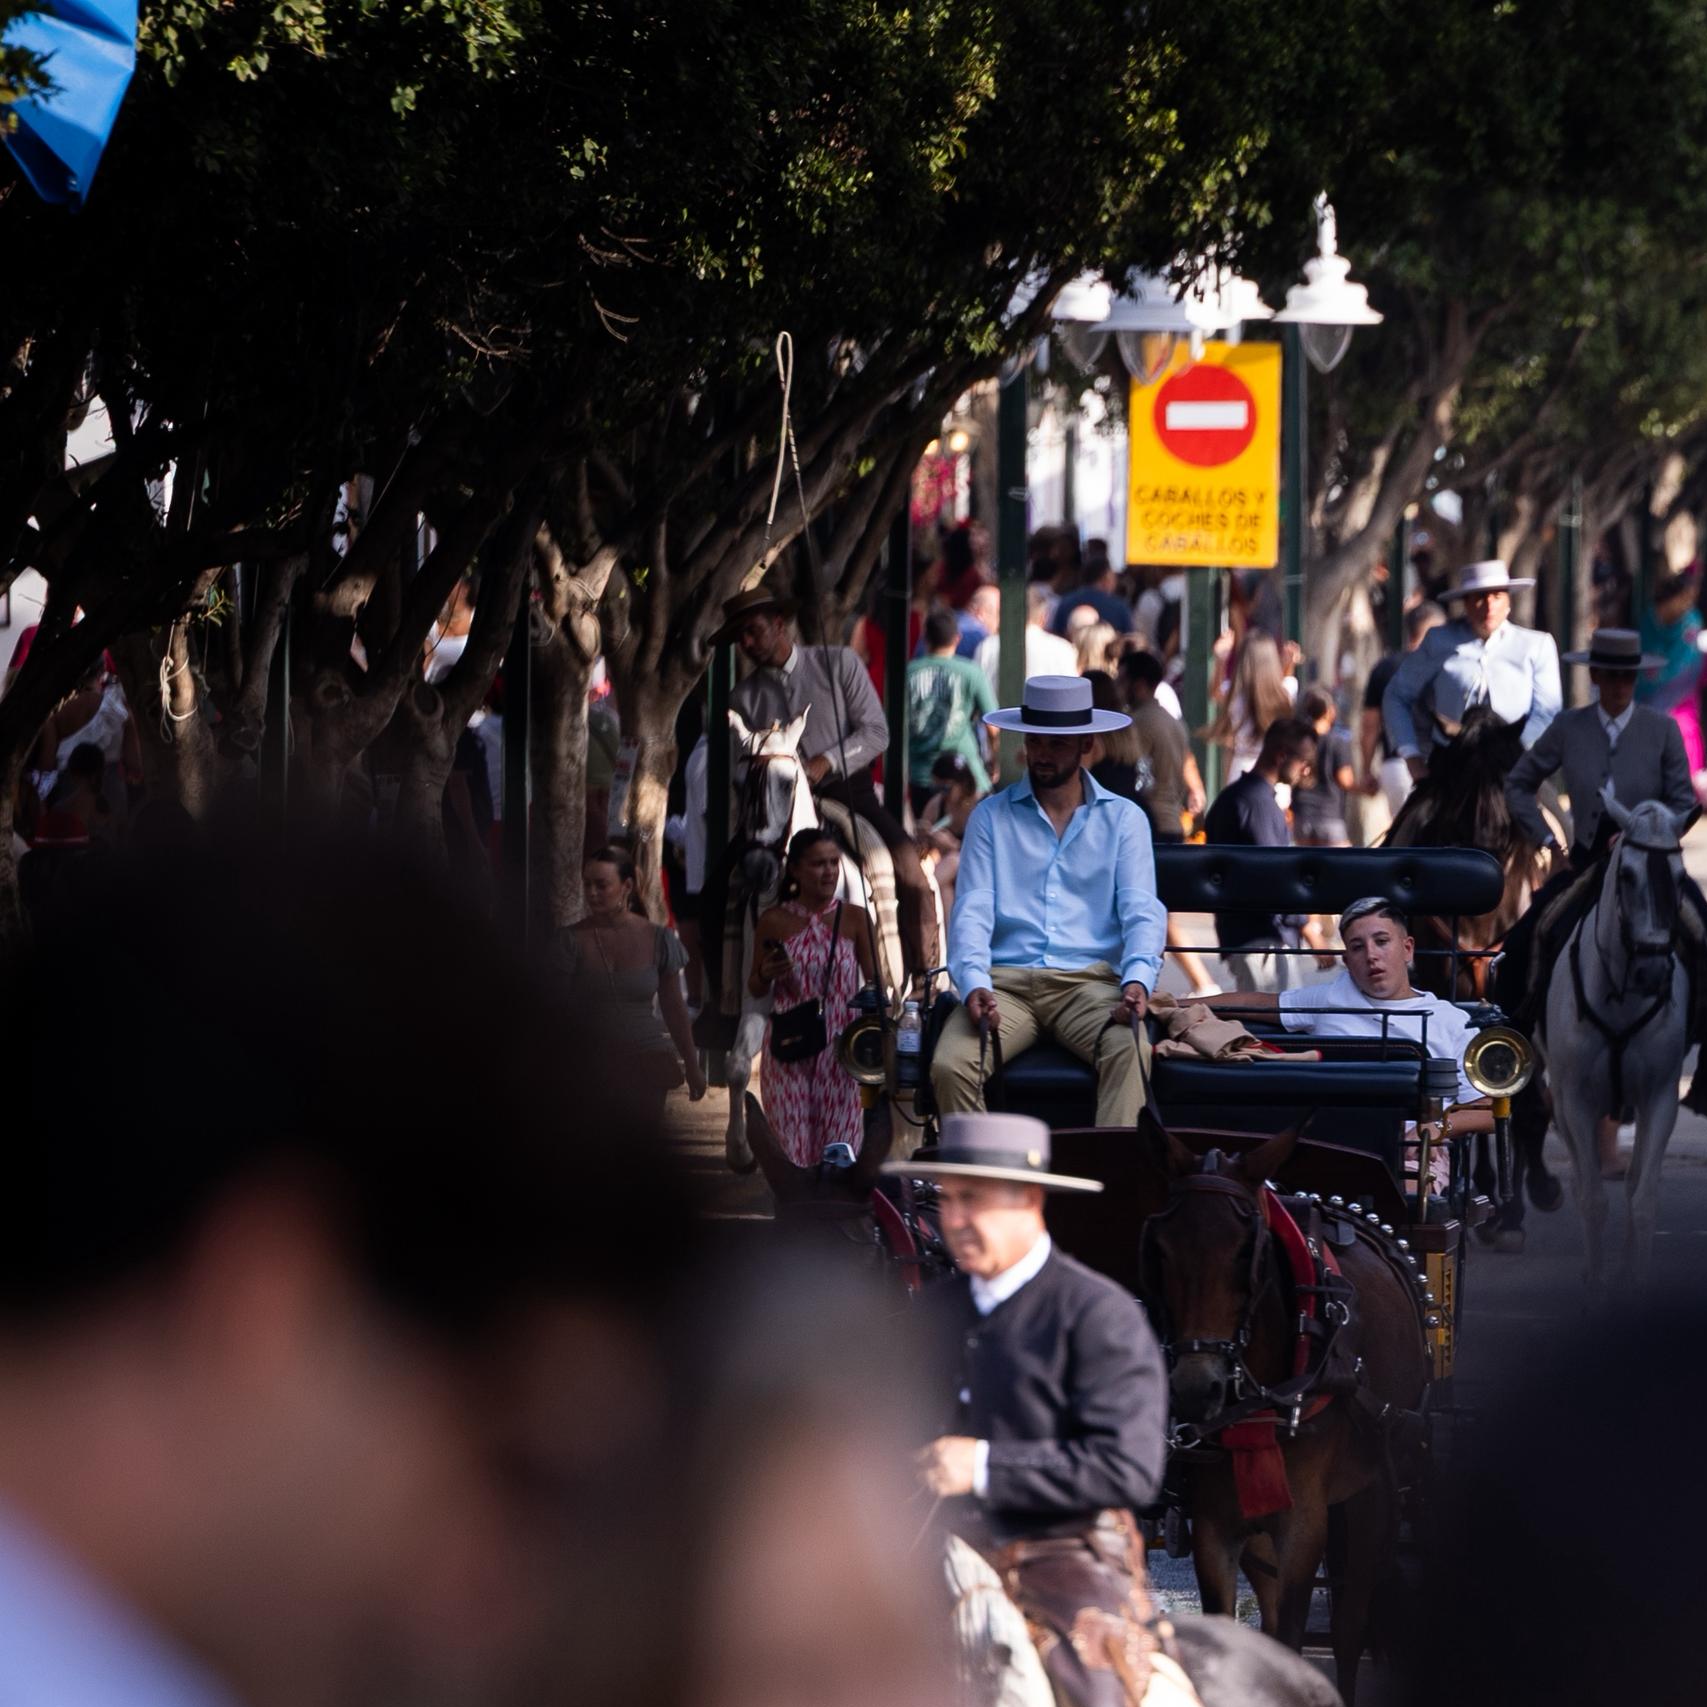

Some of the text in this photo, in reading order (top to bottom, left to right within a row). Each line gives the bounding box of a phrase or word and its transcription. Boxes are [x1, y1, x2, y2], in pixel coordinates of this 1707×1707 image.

[1134, 486, 1267, 507] CABALLOS Y
[1144, 510, 1262, 530] COCHES DE
[1145, 534, 1258, 555] CABALLOS
